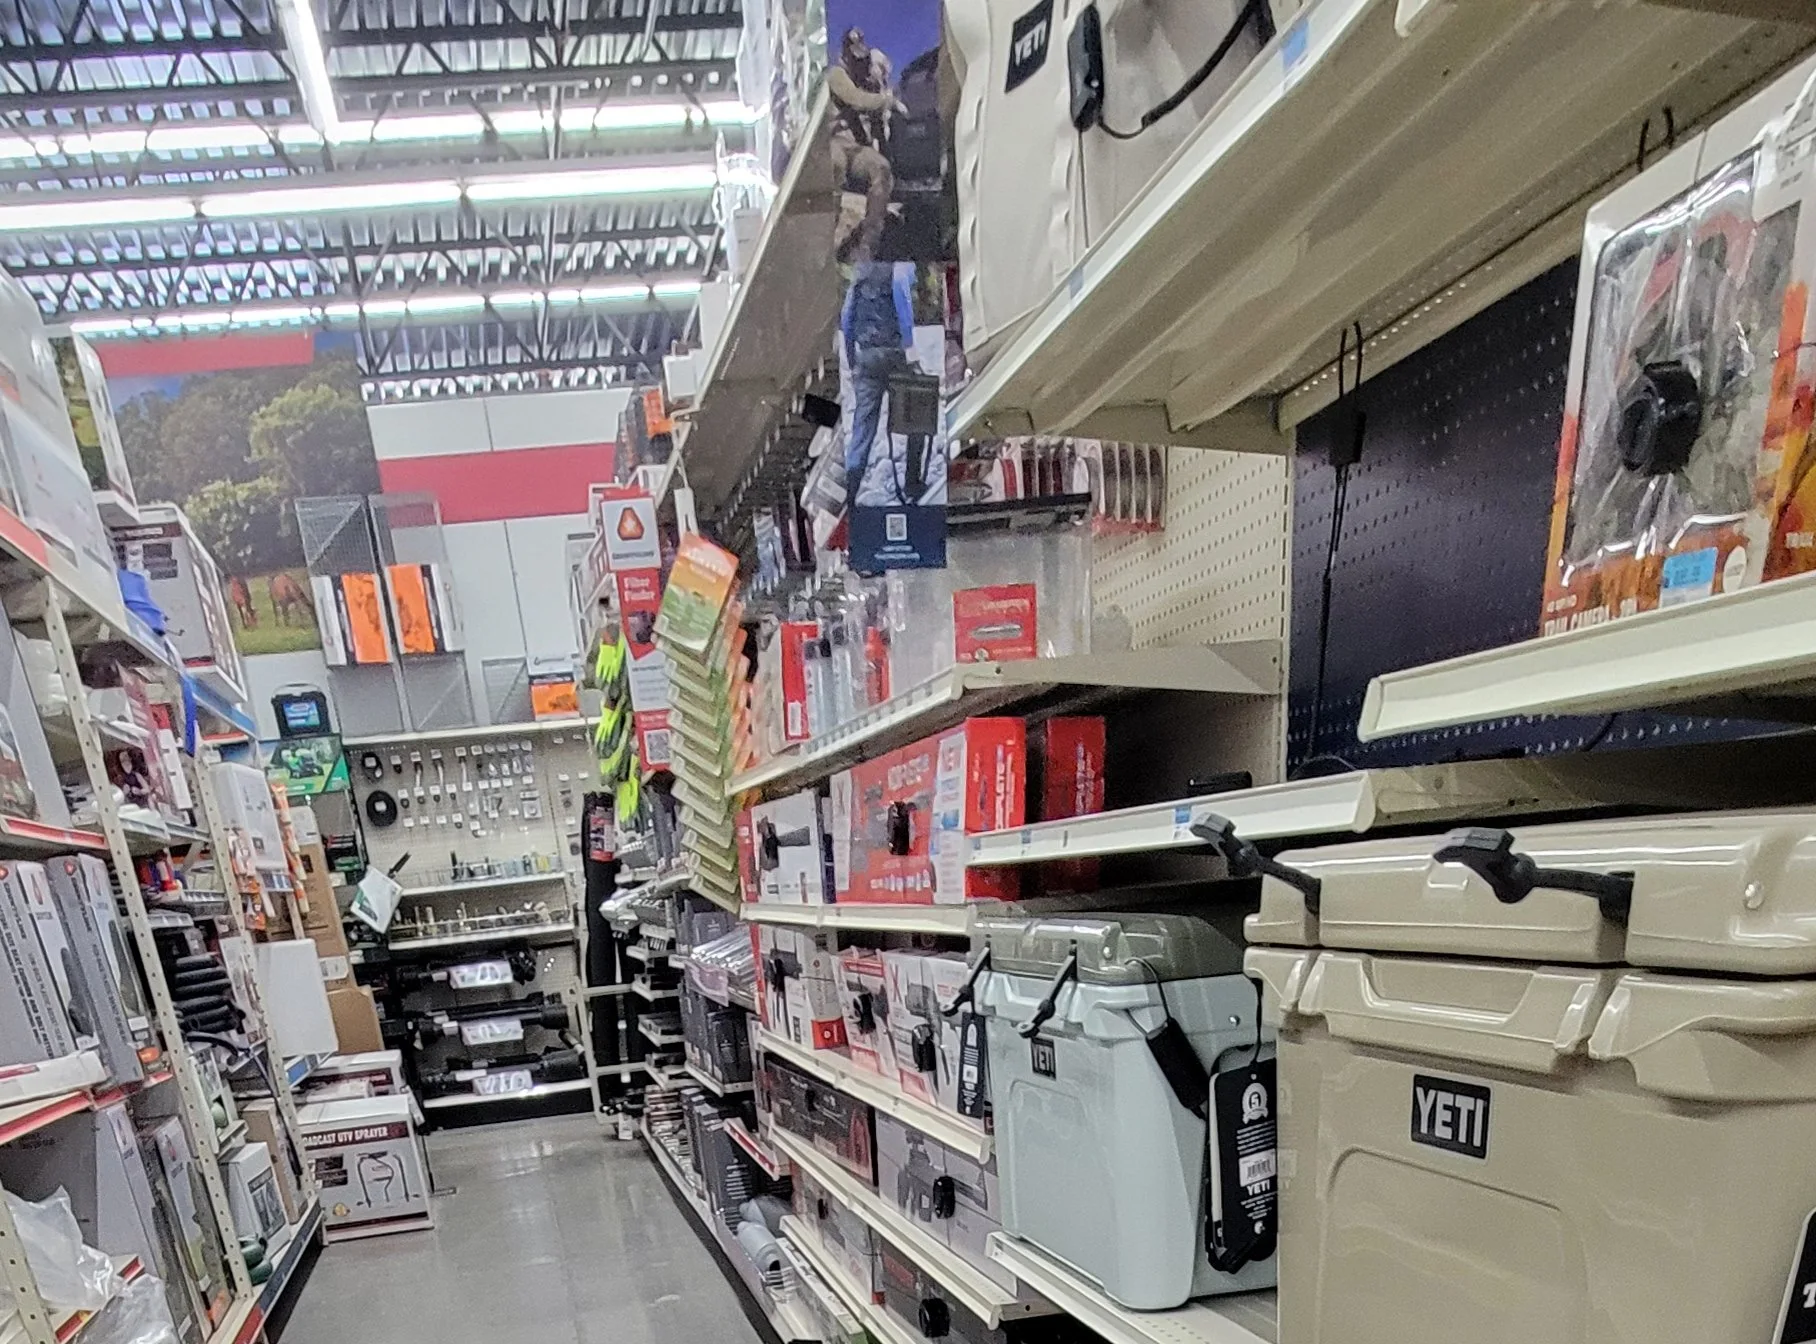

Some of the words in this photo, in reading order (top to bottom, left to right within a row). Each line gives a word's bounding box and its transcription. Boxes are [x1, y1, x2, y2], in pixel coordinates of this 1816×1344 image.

[1015, 18, 1048, 67] YETI
[1033, 1042, 1056, 1077] YETI
[1416, 1086, 1484, 1148] YETI
[1247, 1178, 1271, 1196] YETI
